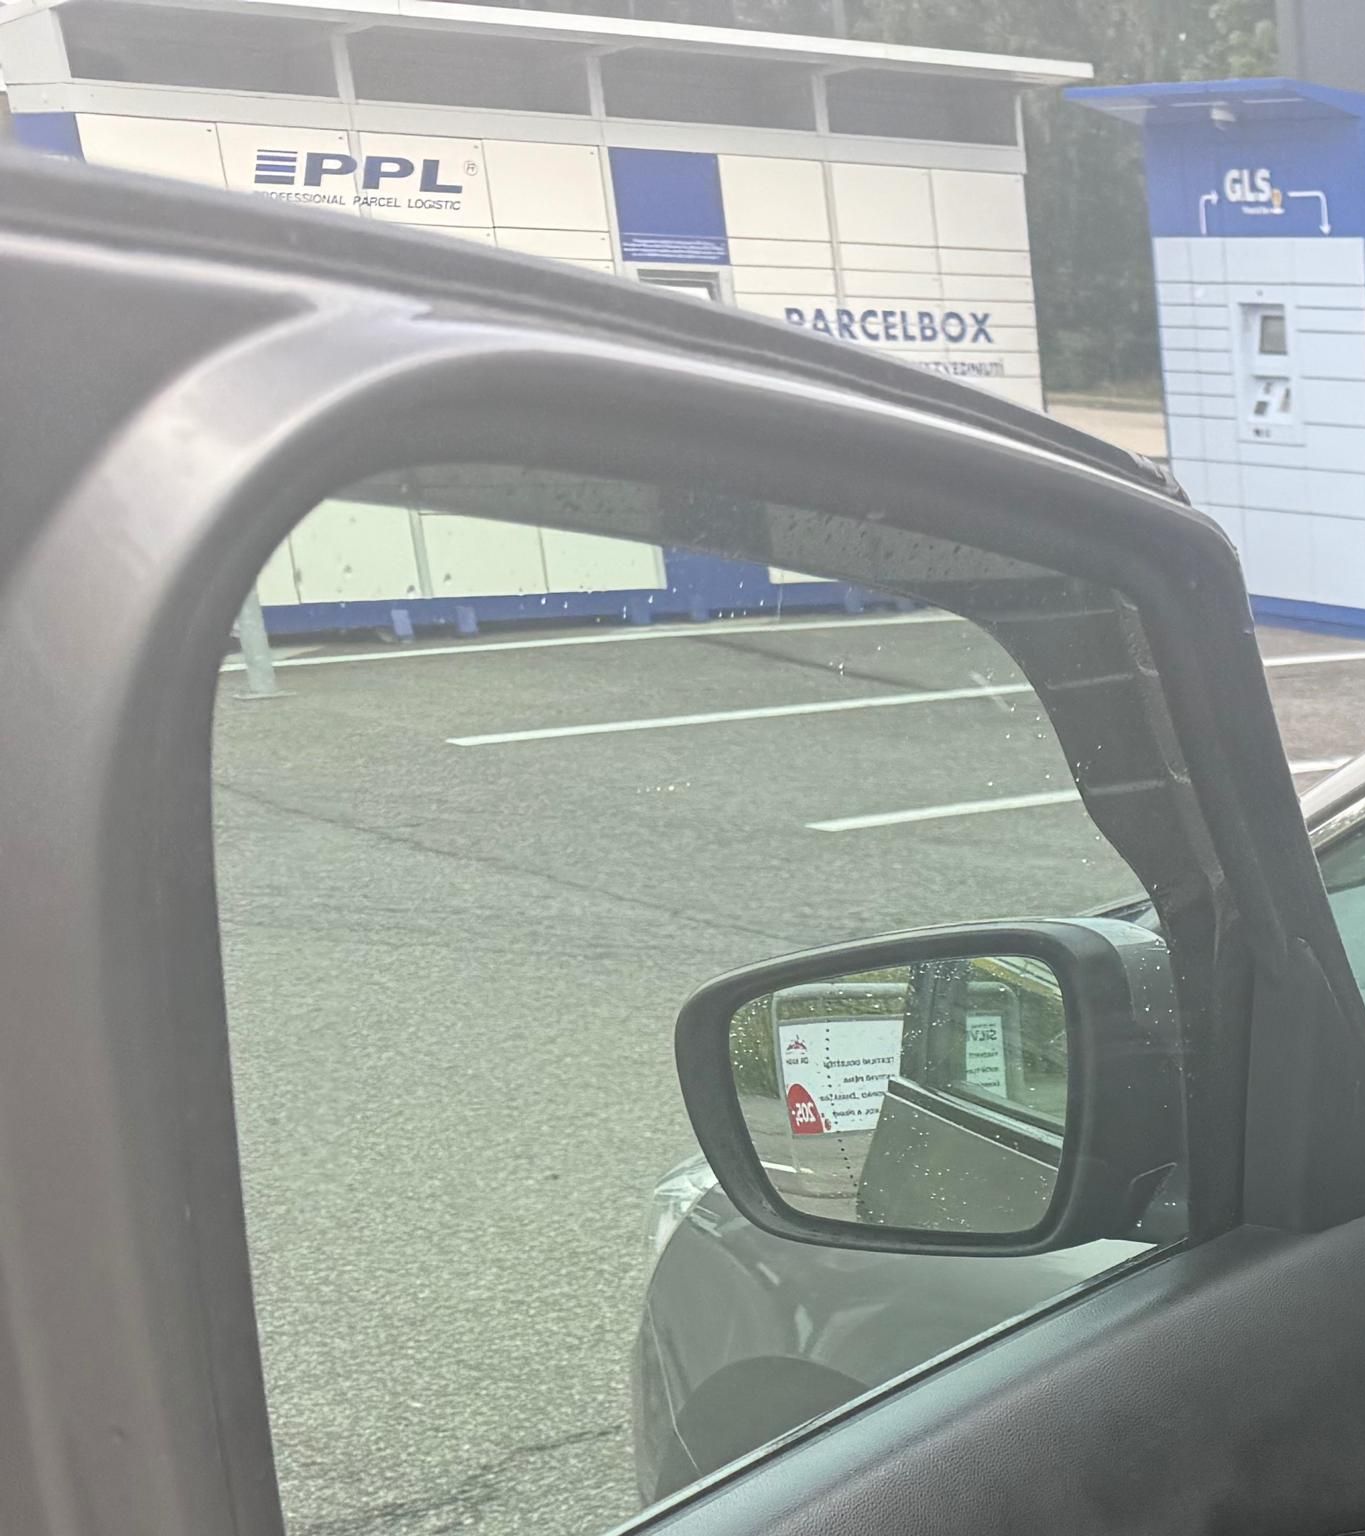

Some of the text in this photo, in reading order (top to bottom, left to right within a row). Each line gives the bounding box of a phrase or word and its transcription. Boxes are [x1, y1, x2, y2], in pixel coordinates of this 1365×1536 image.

[304, 152, 463, 194] PPL
[1223, 168, 1272, 202] GLS
[255, 190, 461, 211] OFESSIONAL PARCEL LOGISTIC
[785, 307, 994, 344] PARCELBOX
